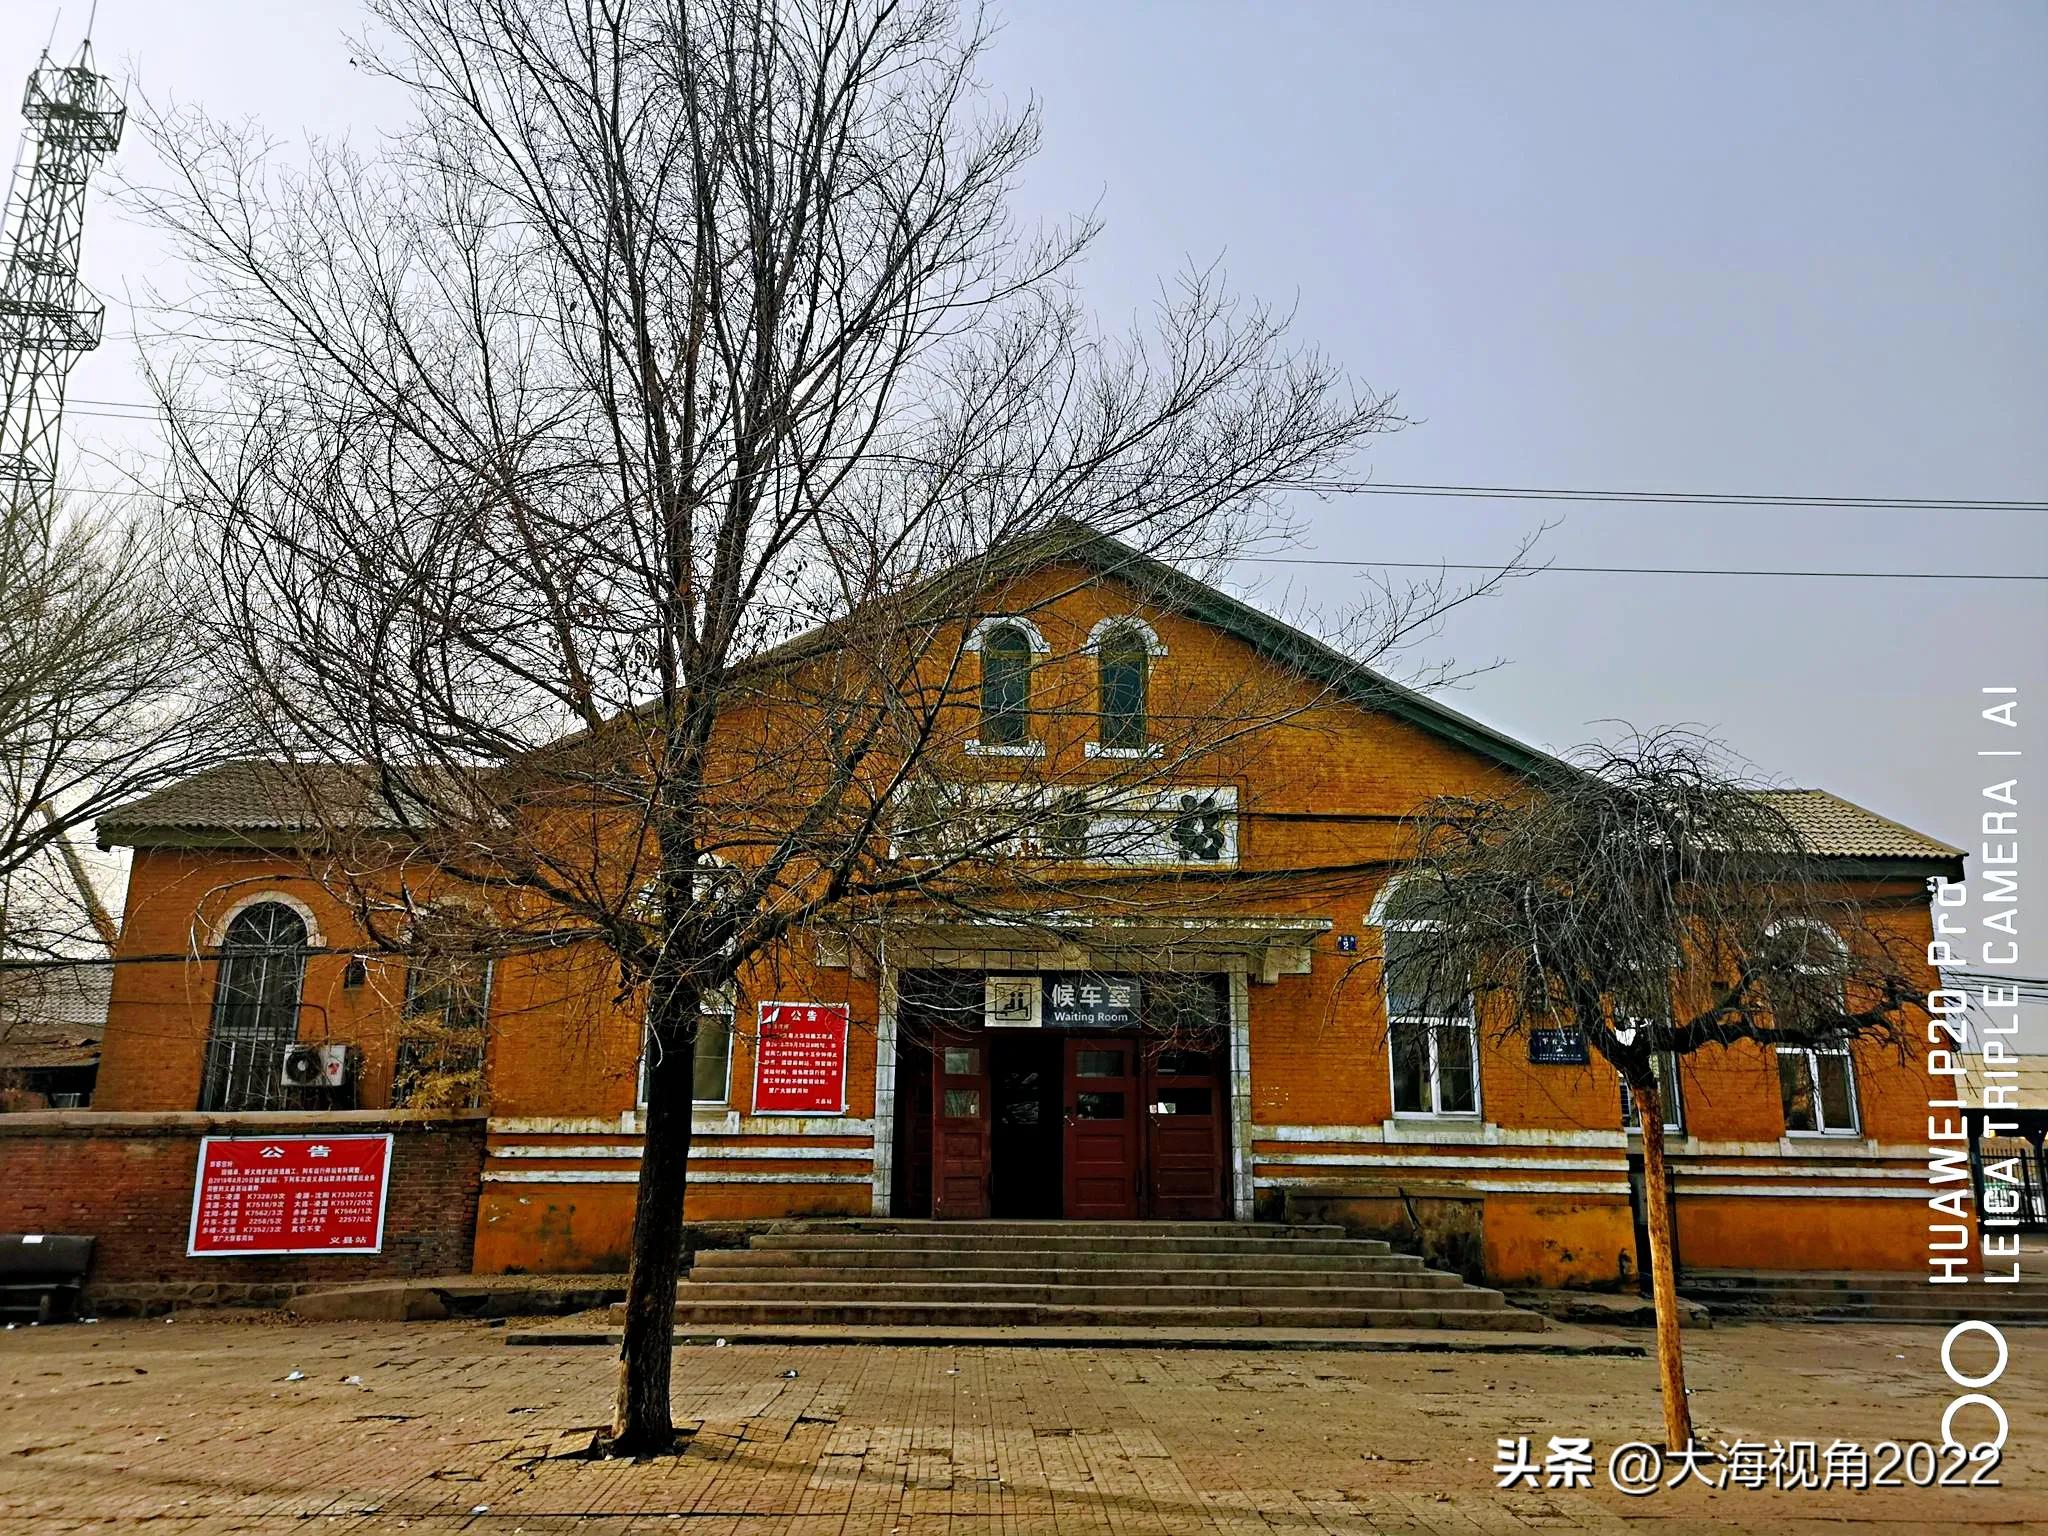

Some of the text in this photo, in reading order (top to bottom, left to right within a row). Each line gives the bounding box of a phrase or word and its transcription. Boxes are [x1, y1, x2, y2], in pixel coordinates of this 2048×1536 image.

[1051, 983, 1131, 1008] 候车室
[791, 1010, 817, 1021] 公告
[1054, 1011, 1128, 1023] Waiting Room
[259, 1145, 333, 1158] 公告
[328, 1236, 367, 1244] 义县站
